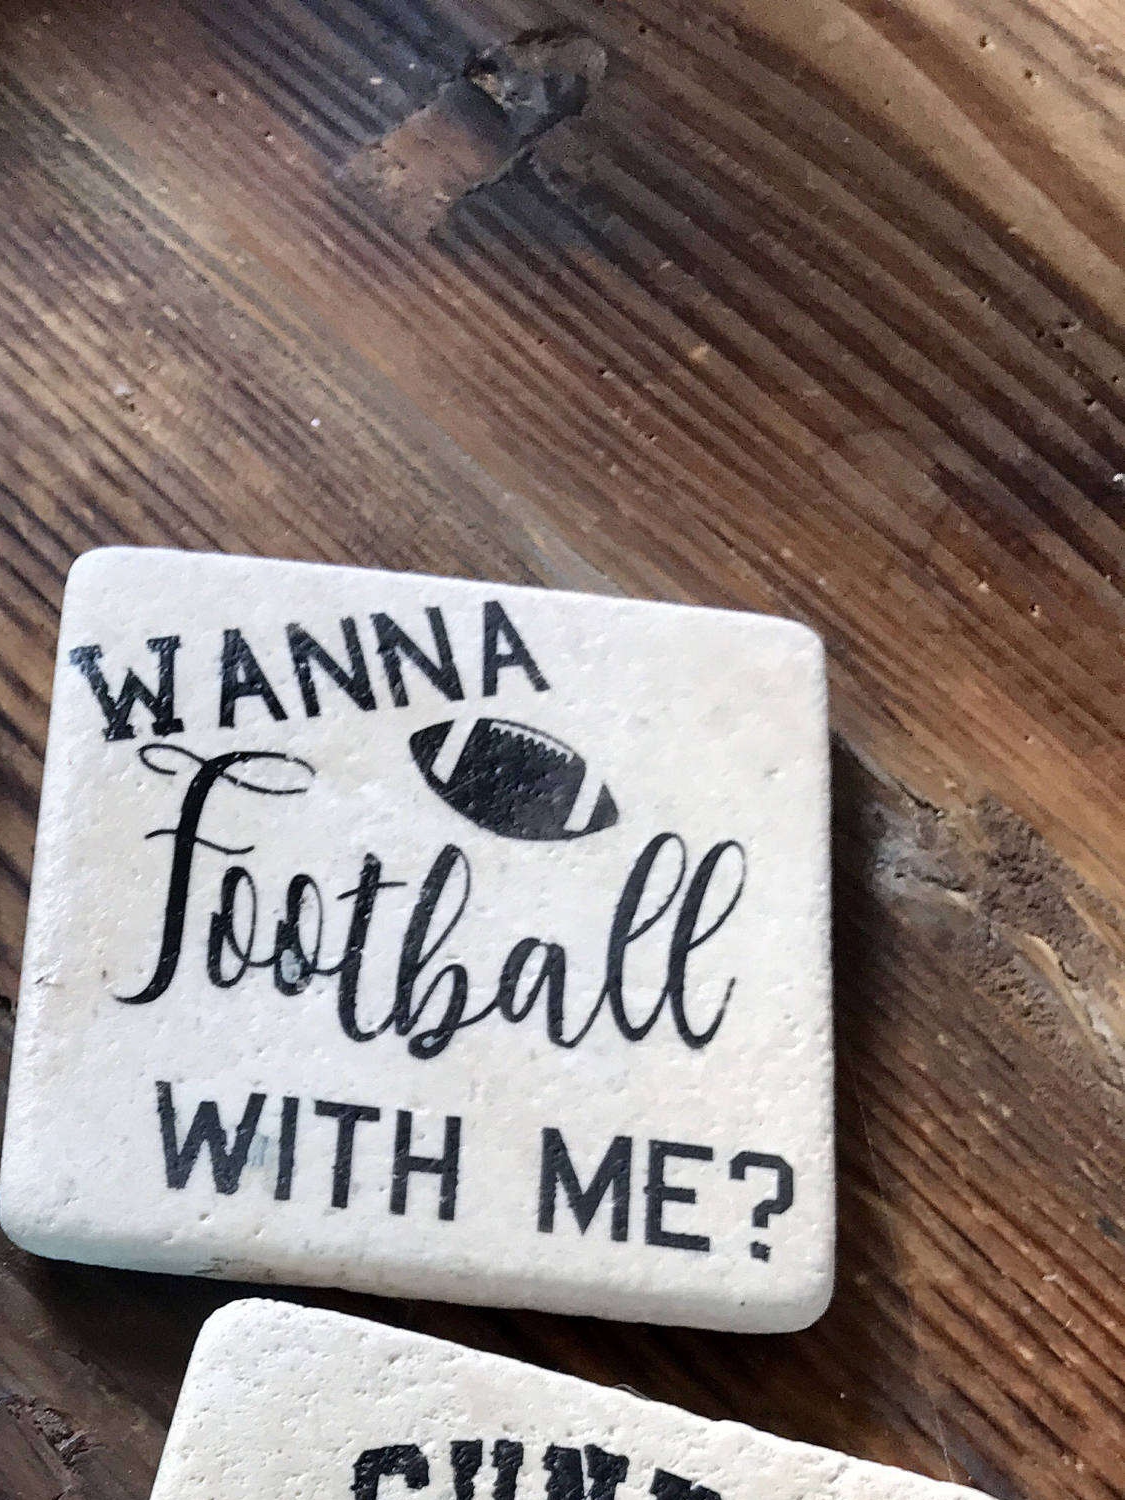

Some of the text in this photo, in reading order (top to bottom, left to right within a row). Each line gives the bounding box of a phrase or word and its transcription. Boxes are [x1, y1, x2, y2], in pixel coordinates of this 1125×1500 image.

[70, 599, 551, 741] WANNA
[114, 743, 747, 1060] Football
[155, 1080, 795, 1263] WITH ME?
